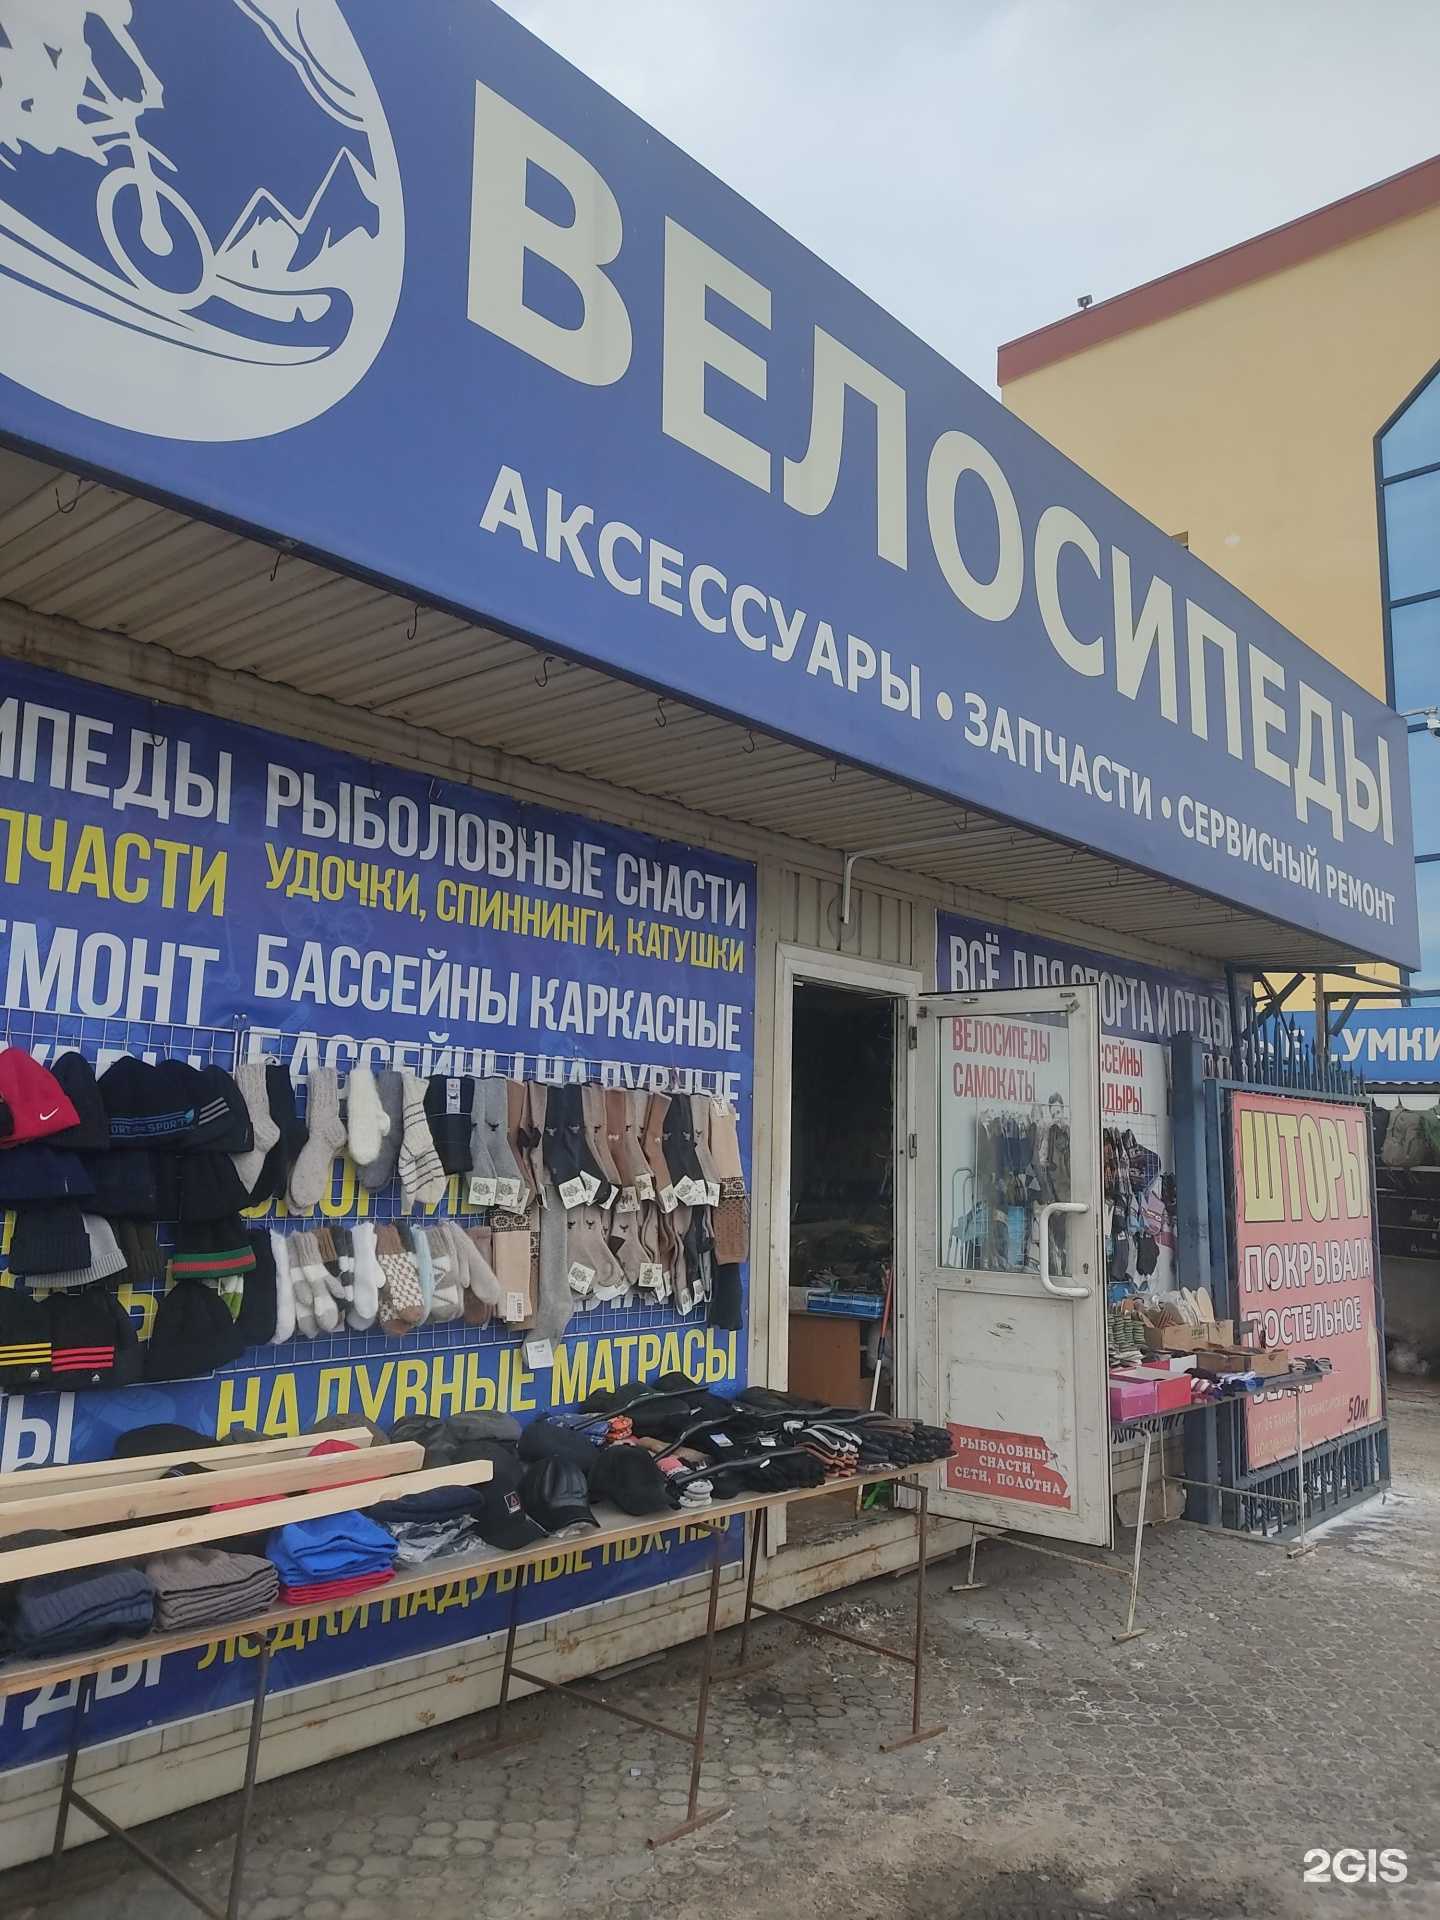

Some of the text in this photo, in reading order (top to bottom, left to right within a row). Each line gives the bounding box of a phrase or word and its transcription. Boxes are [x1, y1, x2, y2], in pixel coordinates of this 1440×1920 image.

[467, 79, 1394, 846] ВЕЛОСИПЕДЫ
[479, 464, 1396, 926] АКСЕССУАРЫ ЗАПЧАСТИ СЕРВИСНЫЙ РЕМОНТ
[265, 762, 747, 930] РЫБОЛОВНЫЕ СНАСТИ
[264, 842, 745, 974] УДОЧКИ, СПИННИНГИ, КАТУШКИ
[0, 918, 220, 1026] МОНТ
[254, 933, 743, 1052] БАССЕЙНЫ КАРКАСНЫЕ
[950, 932, 1001, 992] ВСЁ
[951, 1015, 1051, 1065] ВЕЛОСИПЕДЫ
[1101, 1039, 1143, 1078] СЕЙНЫ
[952, 1062, 1036, 1103] САМОКАТЫ
[1102, 1082, 1143, 1116] ДЫРЫ
[1240, 1109, 1369, 1223] ШТОРЫ
[1244, 1237, 1370, 1294] ПОКРЫВАЛА
[551, 1327, 737, 1407] МАТРАСЫ
[954, 1466, 1061, 1495] СЕТИ, ПОЛОТНА
[979, 1455, 1035, 1477] СНАСТИ,
